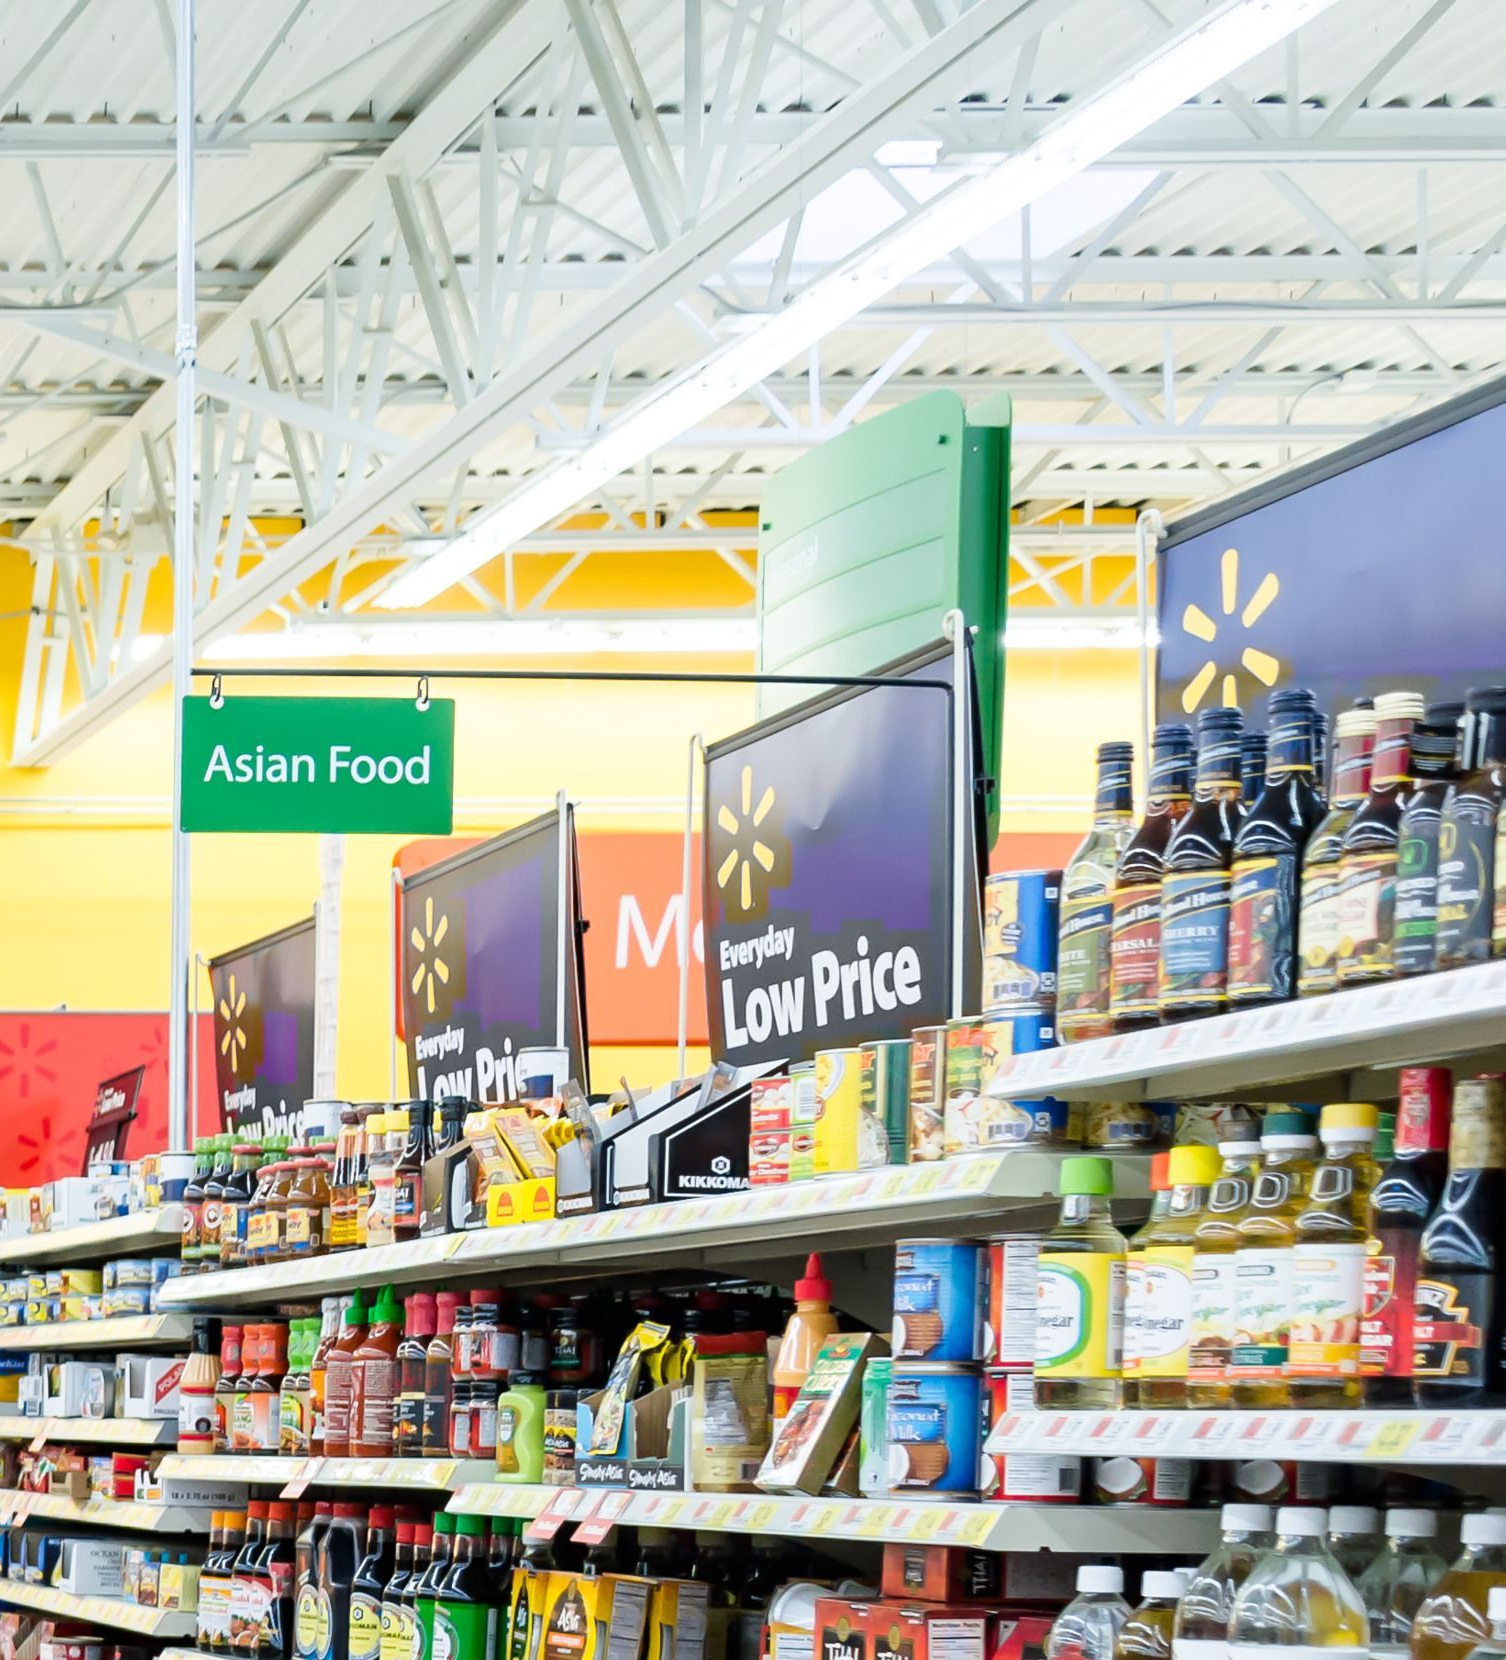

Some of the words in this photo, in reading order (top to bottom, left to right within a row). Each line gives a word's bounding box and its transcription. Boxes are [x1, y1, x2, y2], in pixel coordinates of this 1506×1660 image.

[204, 745, 315, 782] Asian
[329, 746, 430, 784] Food
[720, 925, 794, 972] Everyday
[722, 976, 804, 1049] Low
[811, 935, 921, 1029] Price
[415, 1025, 464, 1061] Everyday
[476, 1037, 525, 1103] Pri
[224, 1085, 256, 1111] Everyday
[678, 1174, 750, 1191] KIKKOMA
[580, 1464, 605, 1482] Simply
[606, 1465, 624, 1479] Asia
[629, 1470, 657, 1488] Simply
[657, 1470, 677, 1486] Asia
